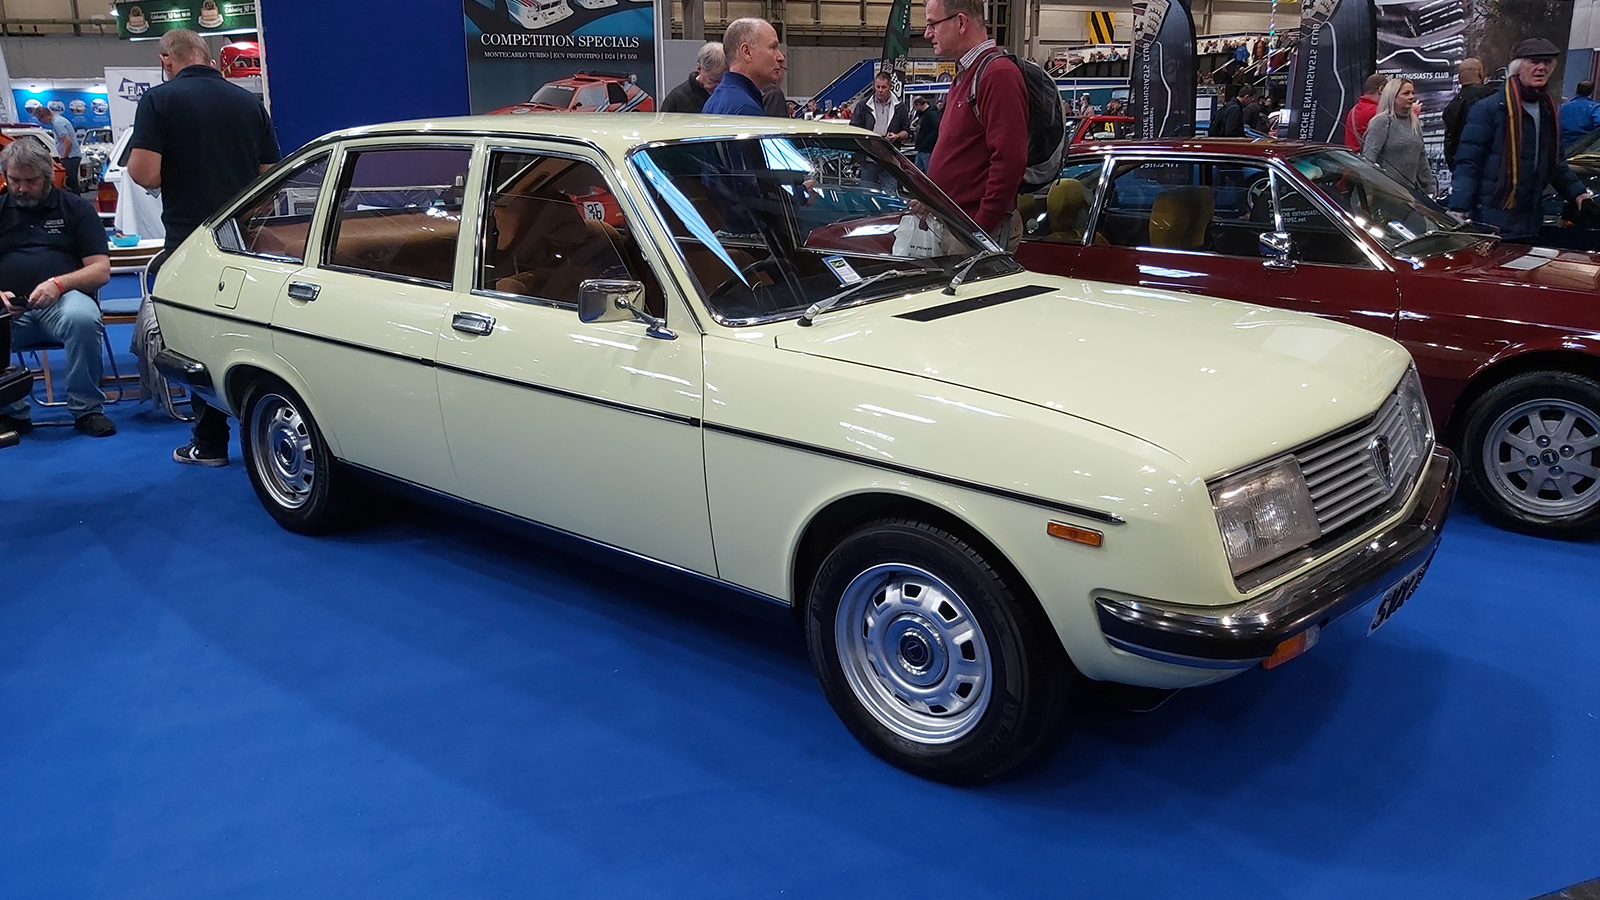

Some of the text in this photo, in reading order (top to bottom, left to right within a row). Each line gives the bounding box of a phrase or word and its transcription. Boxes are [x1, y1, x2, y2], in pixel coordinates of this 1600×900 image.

[480, 33, 640, 49] COMPETITION SPECIALS
[484, 51, 528, 59] MONTECARLO
[528, 51, 550, 59] TURBO
[566, 52, 601, 60] PROTOTIPO
[1395, 72, 1433, 80] ENTHUSIASTS
[1434, 71, 1449, 79] CLUB
[128, 85, 150, 96] FIAT
[1104, 122, 1115, 133] 41
